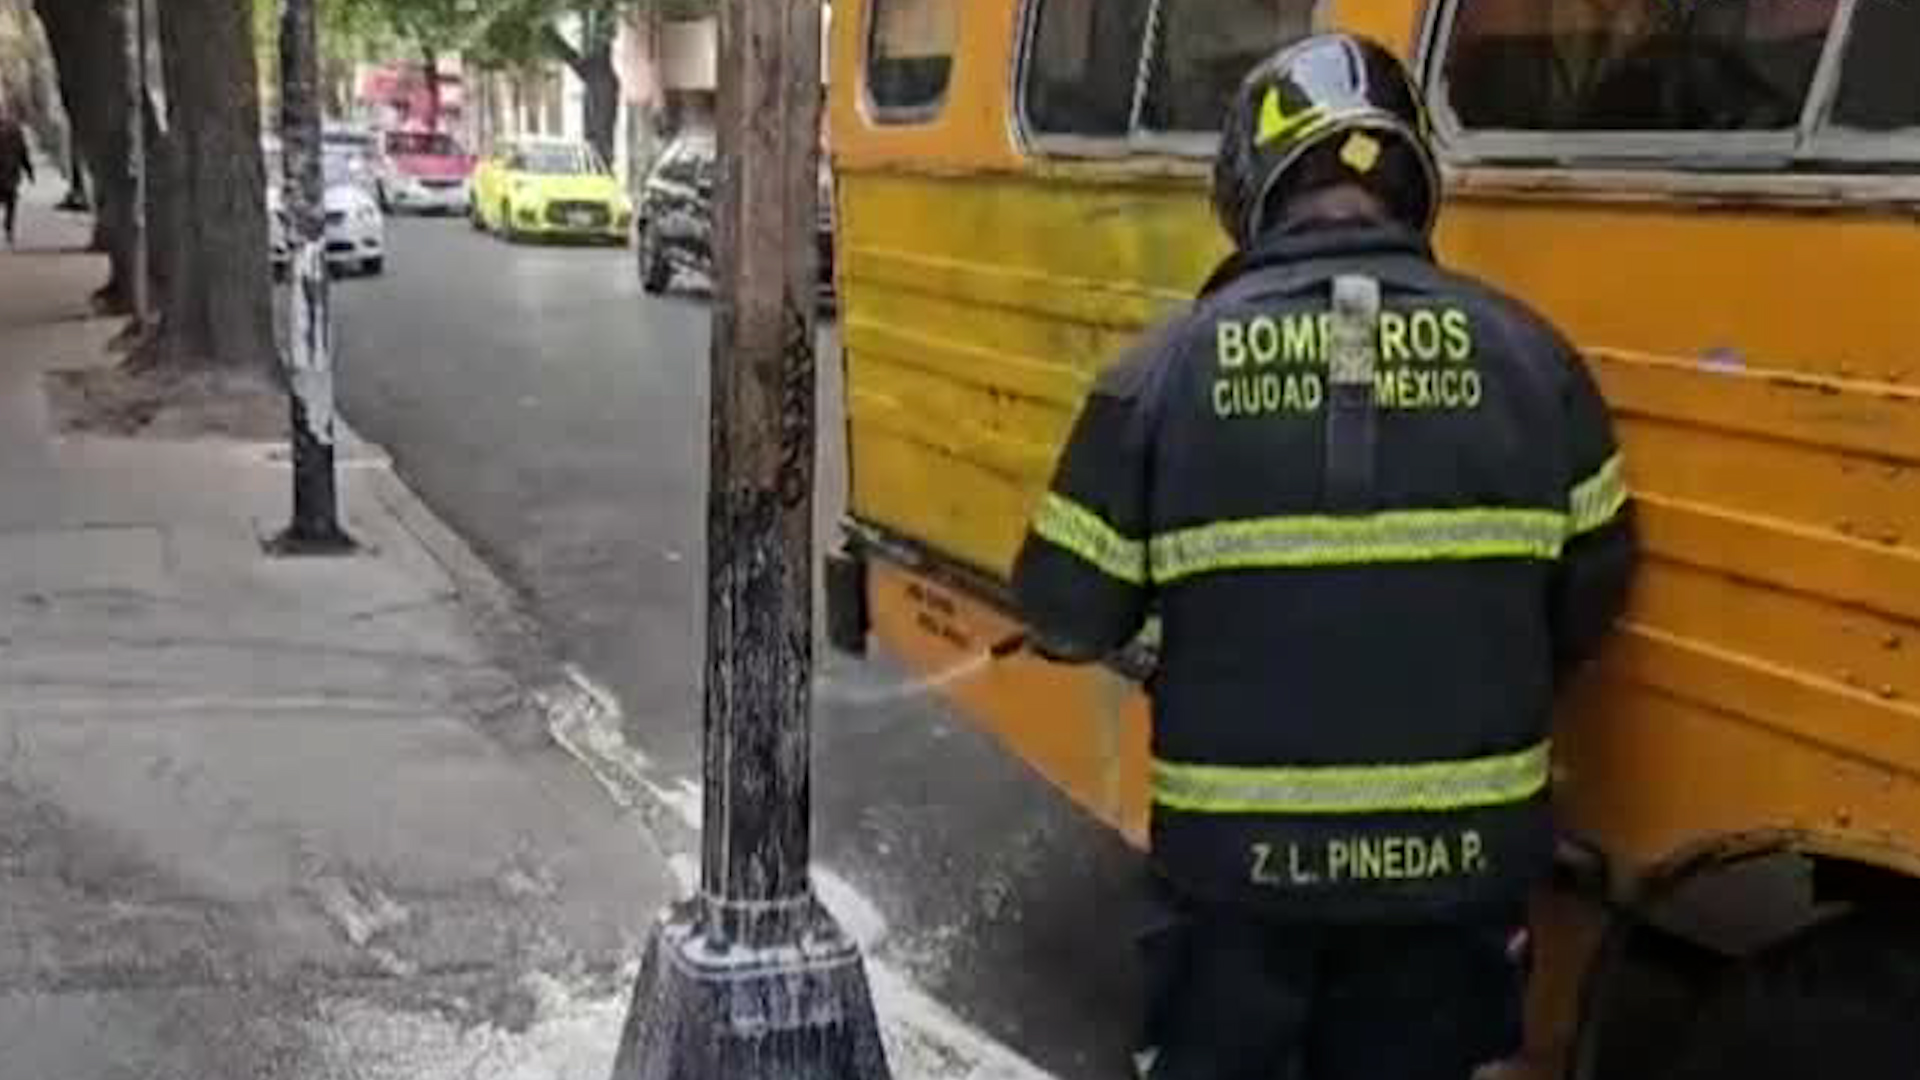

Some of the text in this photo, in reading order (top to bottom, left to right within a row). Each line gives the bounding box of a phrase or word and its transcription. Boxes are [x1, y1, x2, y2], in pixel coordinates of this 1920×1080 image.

[1217, 311, 1471, 367] BOMROS
[1214, 366, 1482, 415] CIUDAD MÉXICO
[1328, 836, 1451, 881] PINEDA
[1461, 829, 1487, 872] P.
